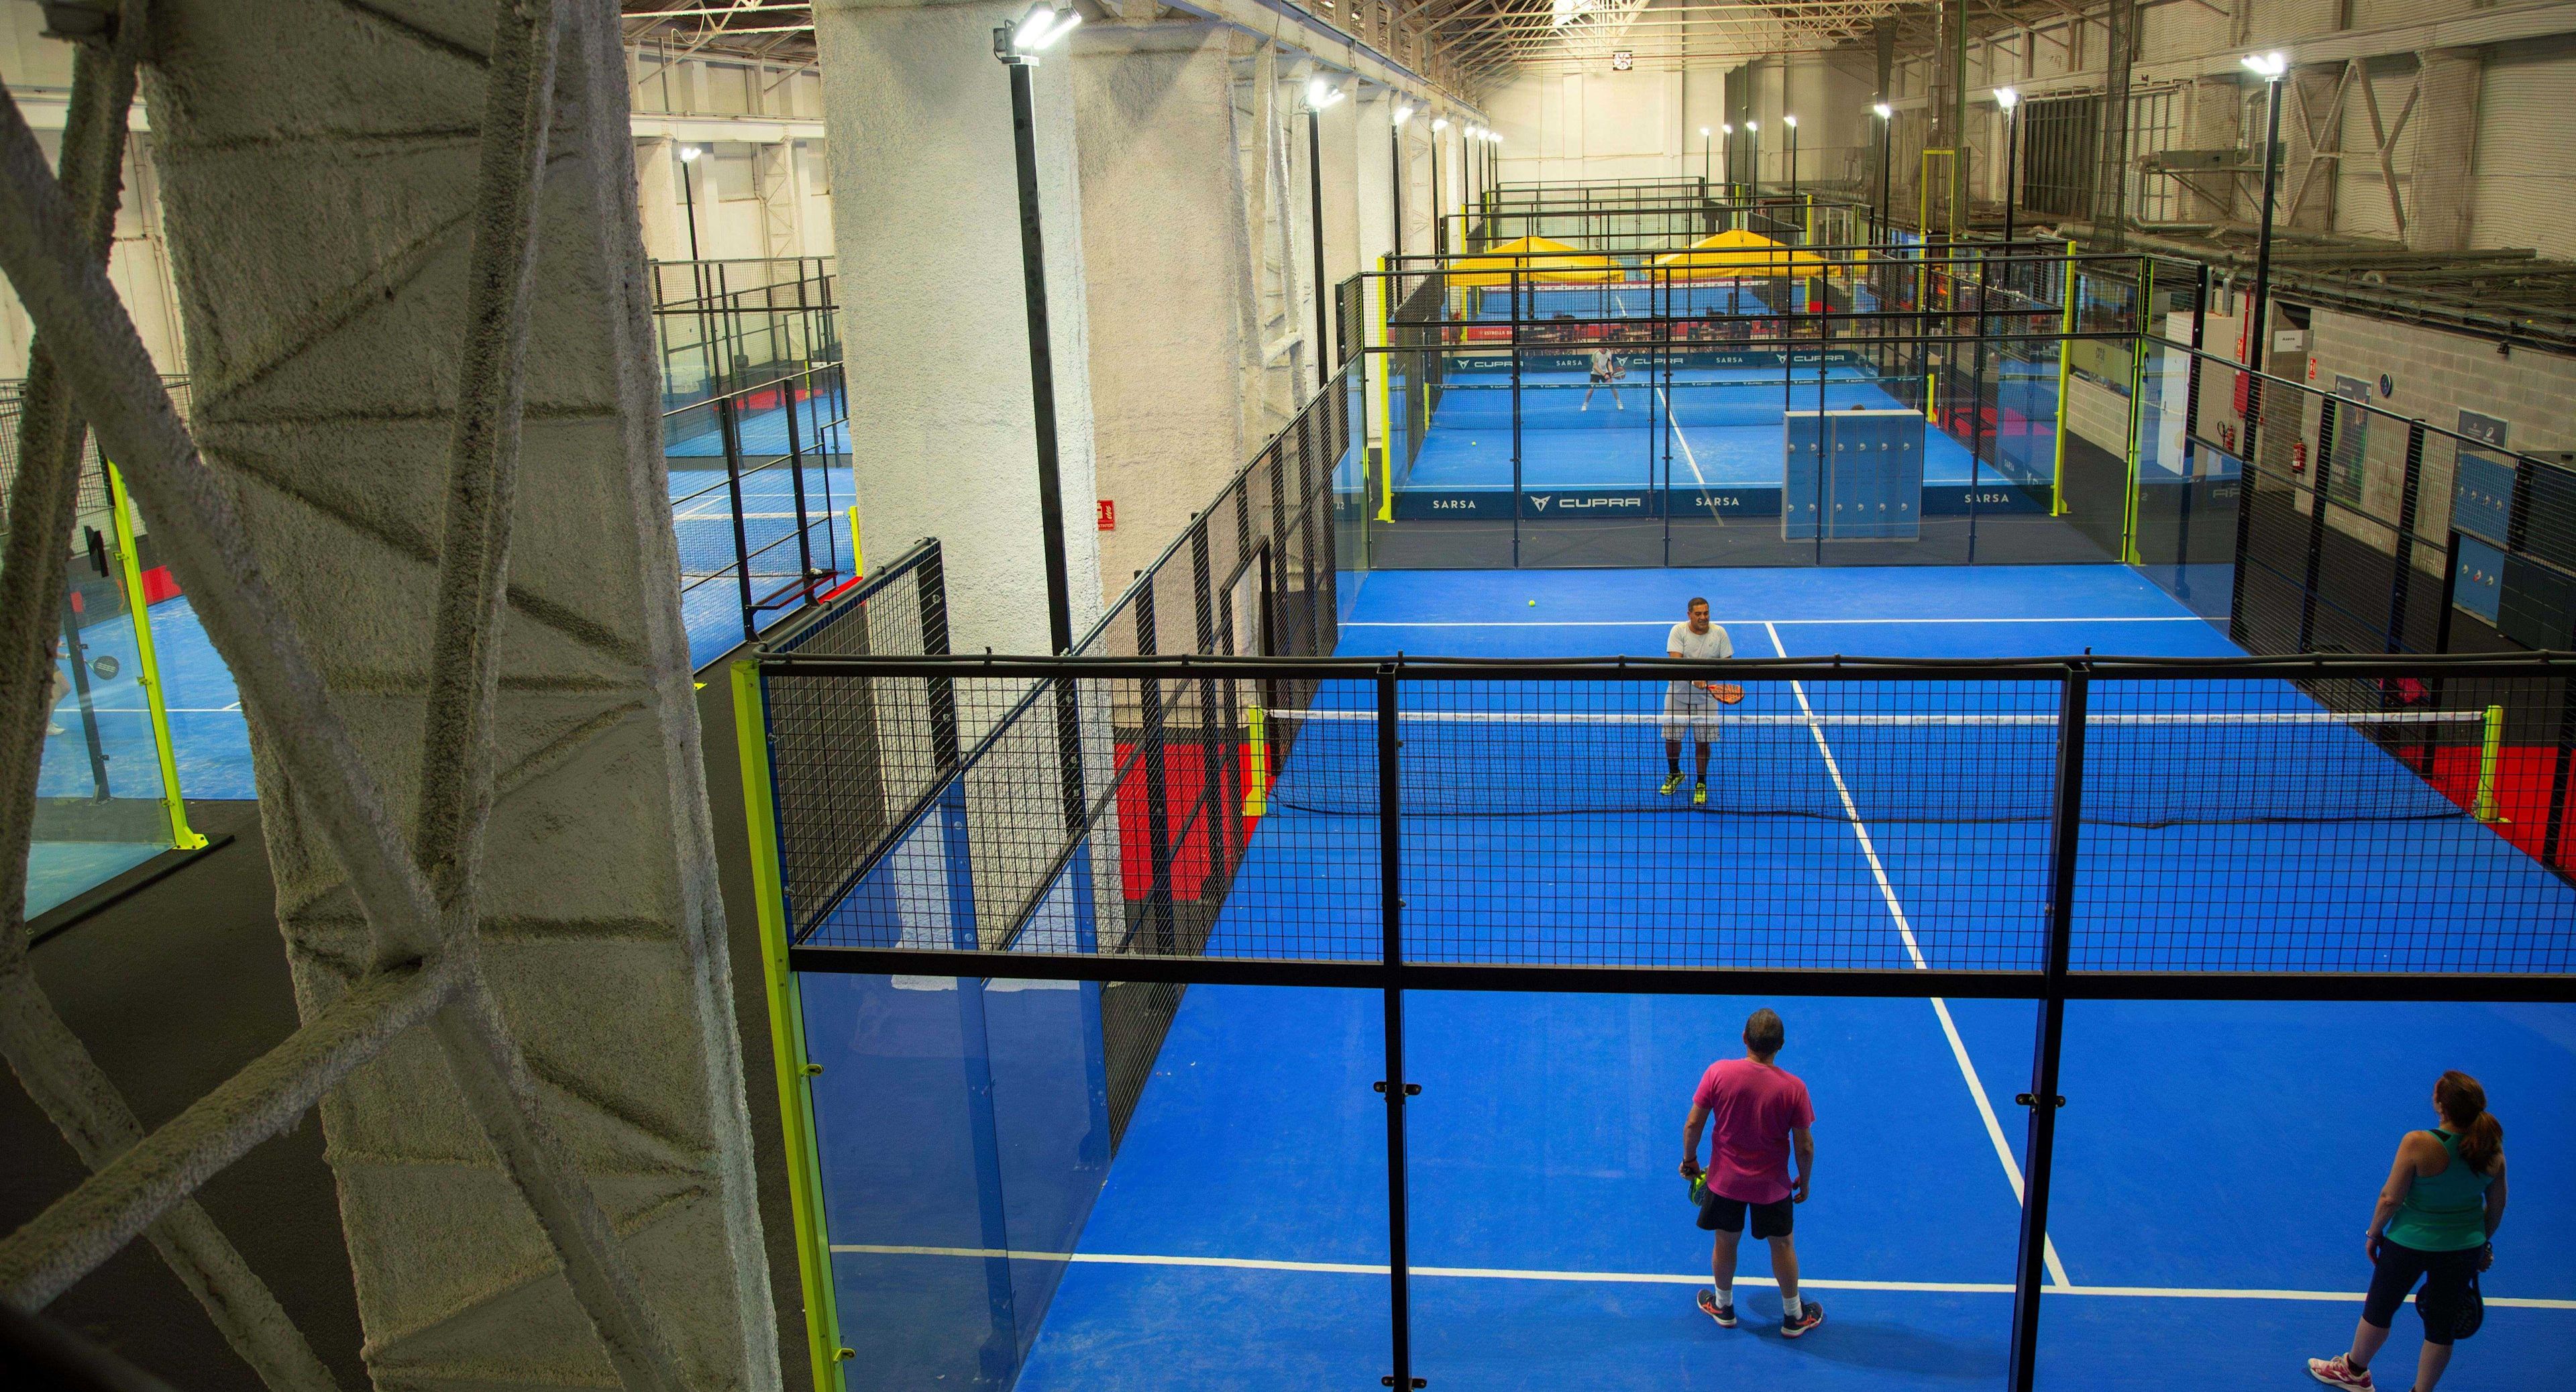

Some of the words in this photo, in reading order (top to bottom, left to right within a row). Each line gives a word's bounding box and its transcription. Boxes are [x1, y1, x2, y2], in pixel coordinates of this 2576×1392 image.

[1433, 500, 1477, 509] SARSA
[1559, 498, 1641, 508] CUPRA
[1695, 497, 1739, 506] SARSA
